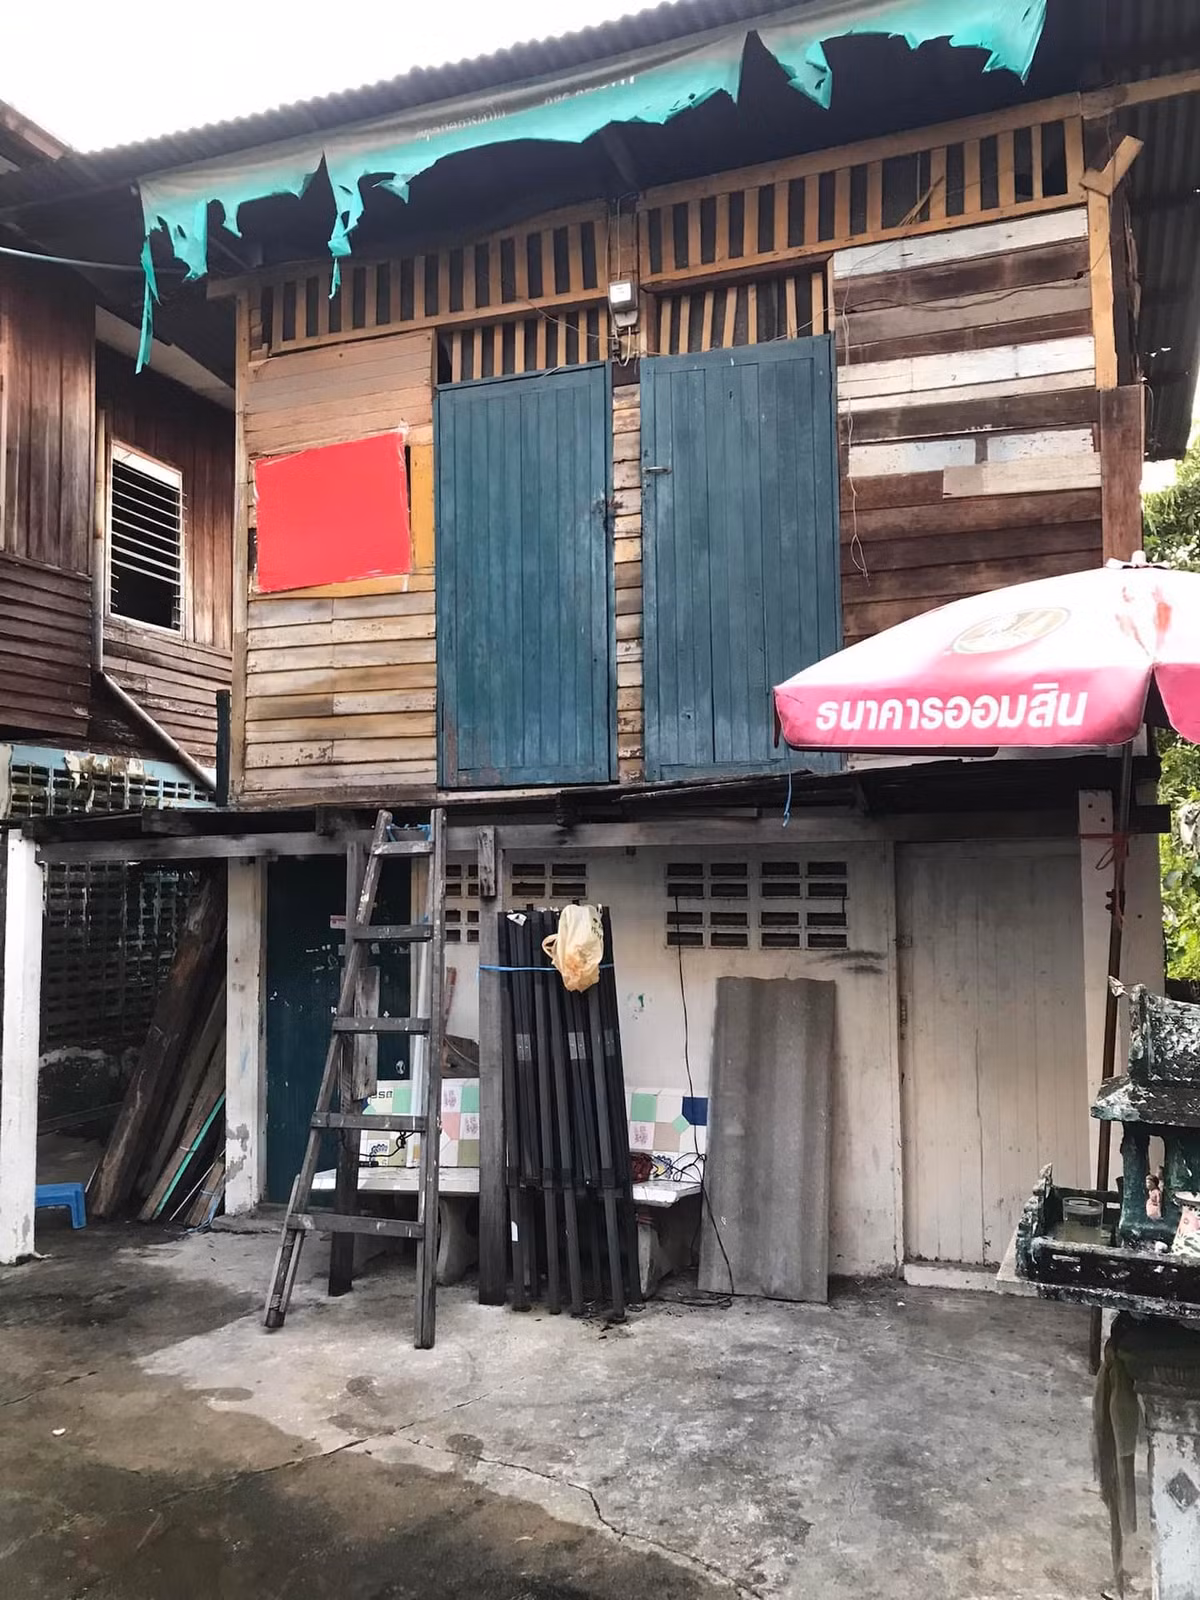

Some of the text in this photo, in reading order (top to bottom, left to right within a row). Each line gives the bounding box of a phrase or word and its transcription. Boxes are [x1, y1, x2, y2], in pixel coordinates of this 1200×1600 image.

[815, 682, 1089, 731] ธนาคารออมสิน
